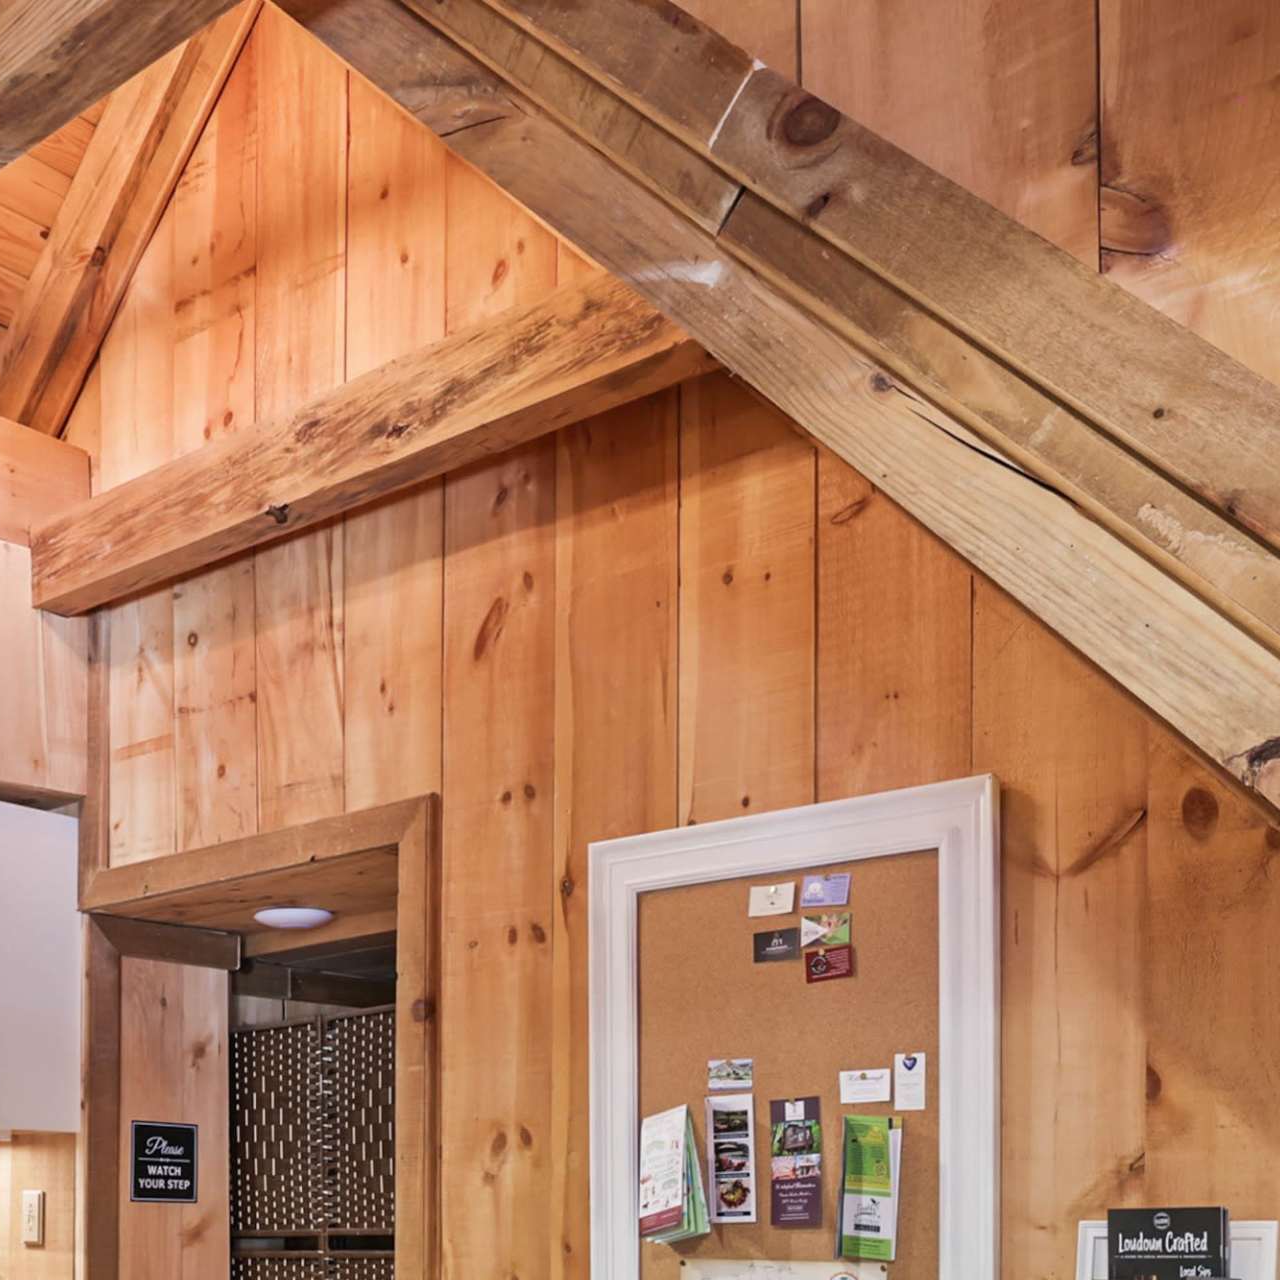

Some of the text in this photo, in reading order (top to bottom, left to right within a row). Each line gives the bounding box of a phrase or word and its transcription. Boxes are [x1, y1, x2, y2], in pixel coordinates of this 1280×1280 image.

[145, 1136, 184, 1155] Please
[147, 1165, 182, 1176] WATCH
[138, 1178, 191, 1190] YOUR STEP
[1118, 1231, 1208, 1254] Loudoun Crafted
